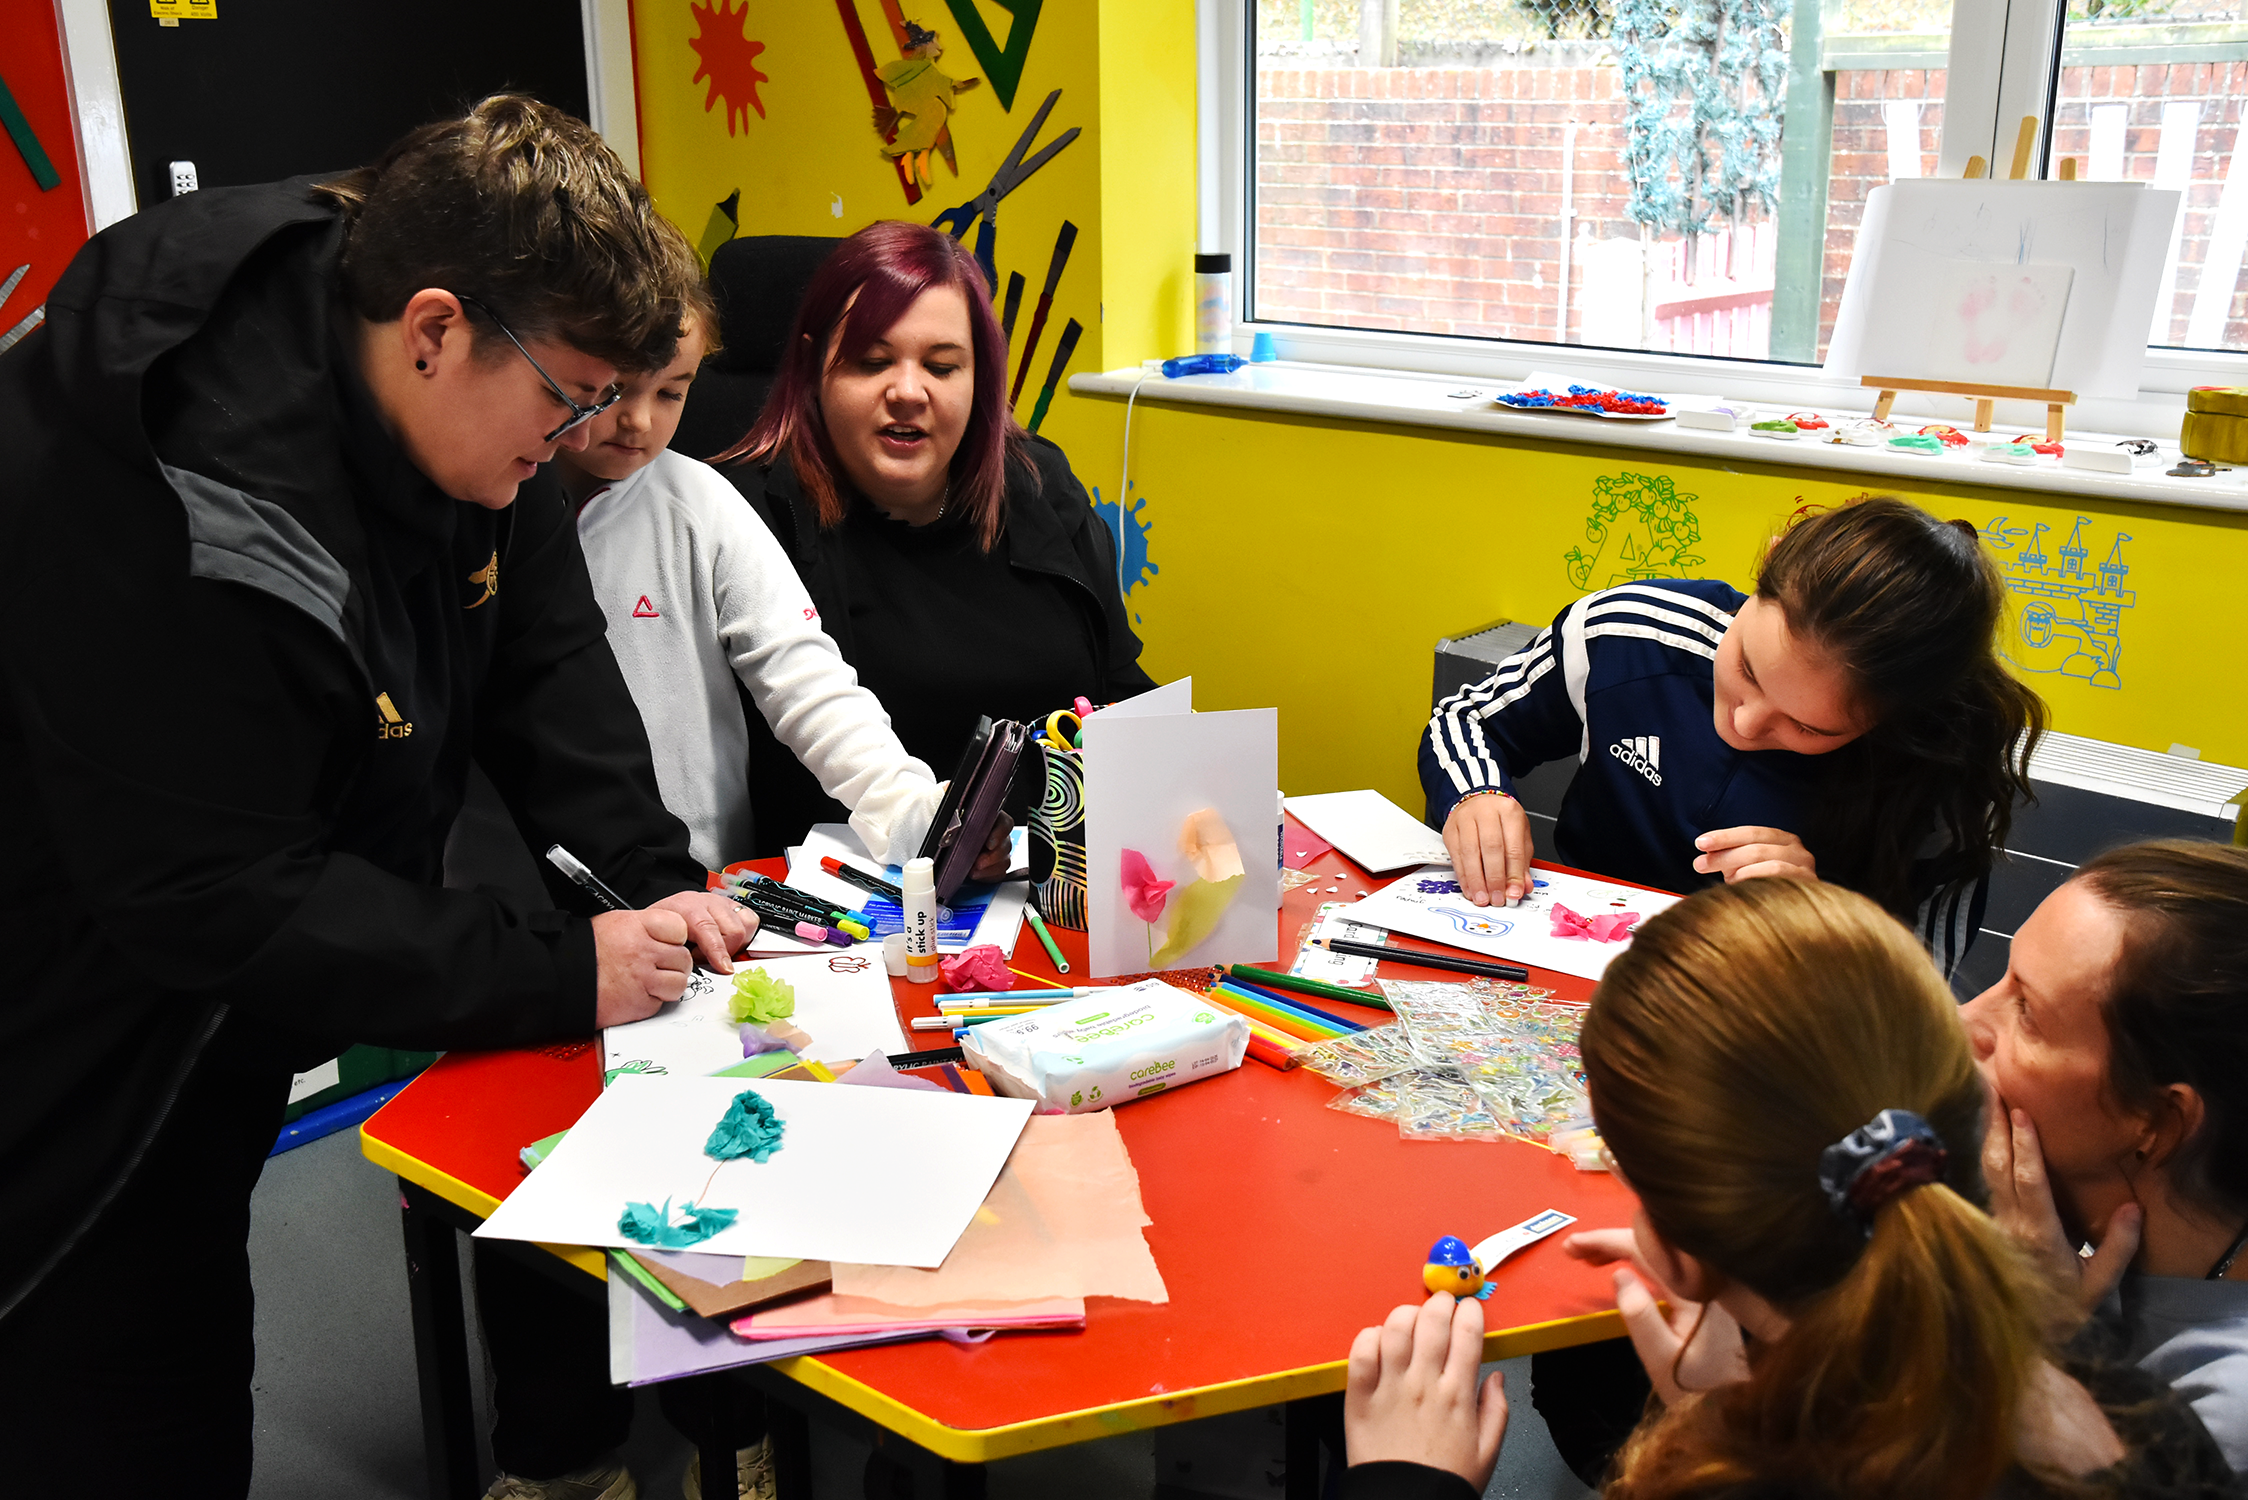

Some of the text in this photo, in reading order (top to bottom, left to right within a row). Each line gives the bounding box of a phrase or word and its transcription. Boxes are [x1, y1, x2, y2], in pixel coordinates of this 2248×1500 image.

[378, 722, 413, 739] das
[1609, 744, 1662, 787] adidas
[798, 911, 822, 923] MARKER
[915, 911, 927, 954] stick up
[1343, 922, 1363, 940] Card
[1074, 1013, 1155, 1043] careBee
[1130, 1059, 1176, 1081] careBee
